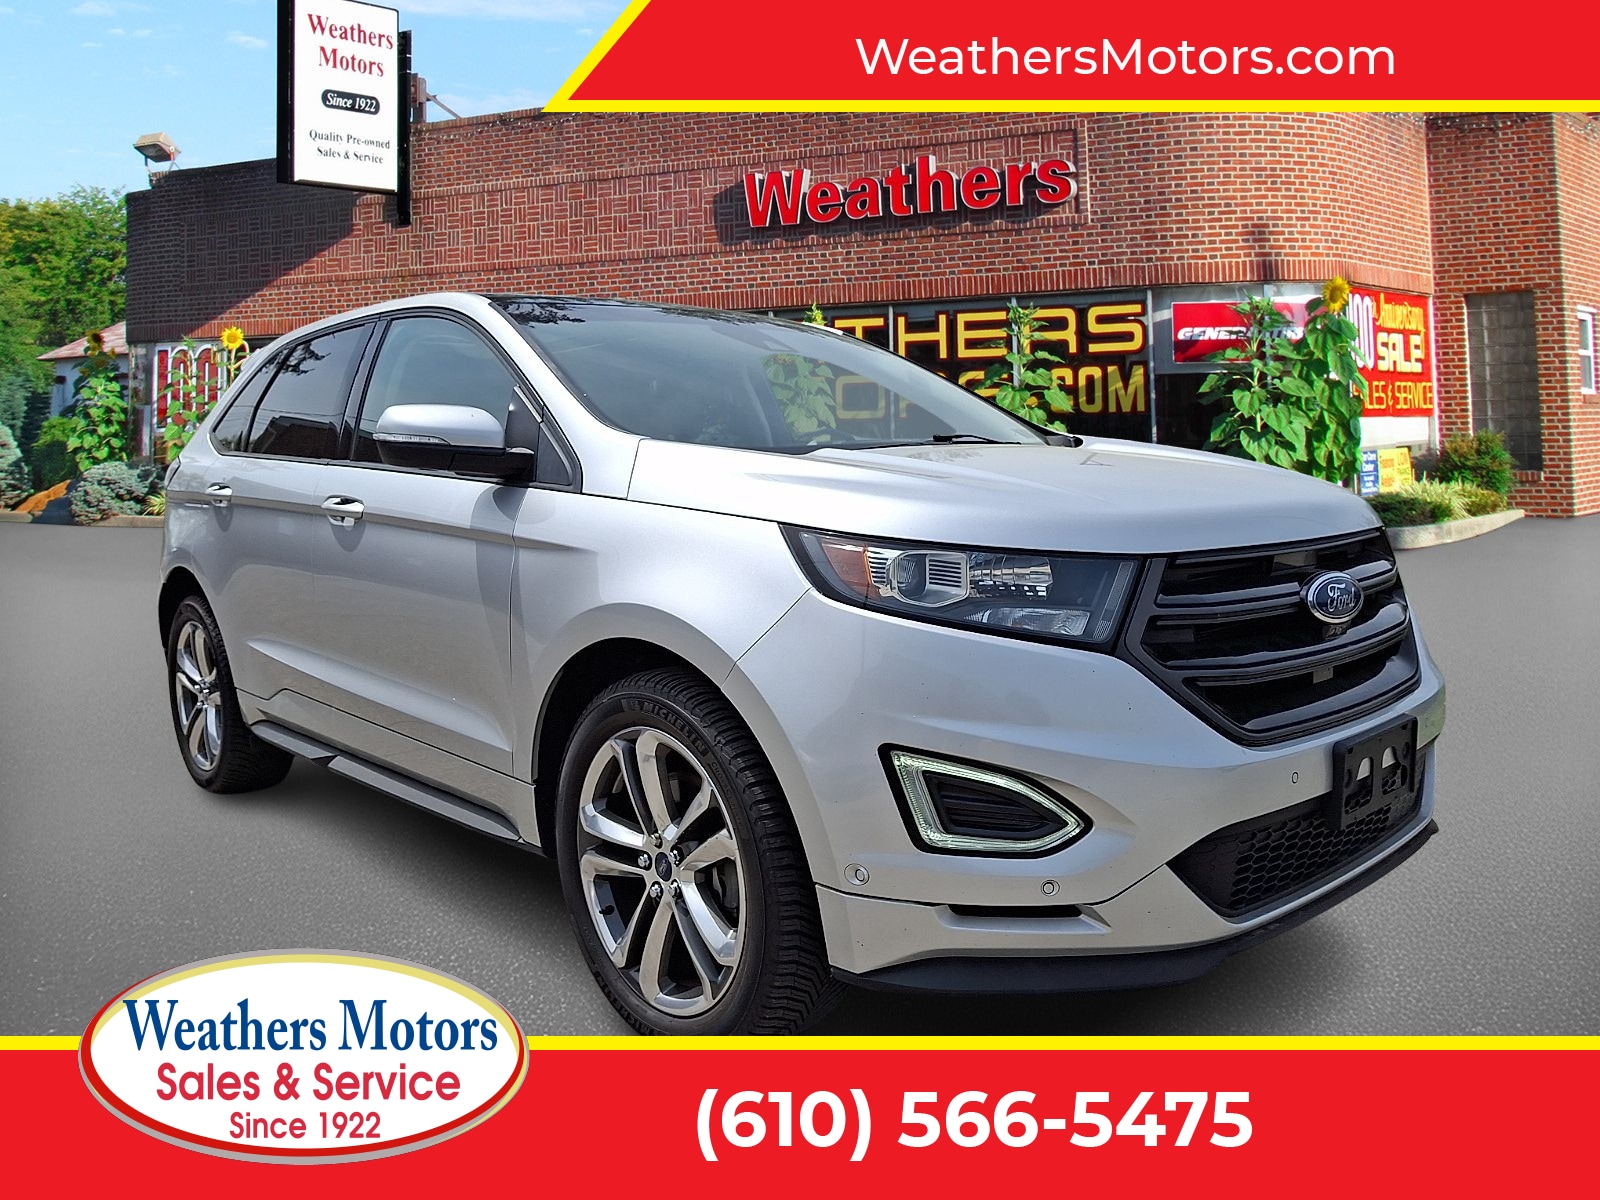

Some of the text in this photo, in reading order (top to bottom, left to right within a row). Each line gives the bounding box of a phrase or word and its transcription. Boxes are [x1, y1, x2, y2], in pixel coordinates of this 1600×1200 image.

[307, 13, 394, 50] Weathers
[319, 46, 384, 77] Motors
[326, 92, 376, 112] Since 1922
[309, 129, 391, 150] Quality Pre-owned
[316, 146, 384, 164] Sales & Service
[743, 155, 1078, 228] Weathers
[1376, 331, 1423, 374] SALE
[1394, 381, 1434, 409] SERVICE
[1327, 583, 1356, 612] Ford
[643, 701, 707, 754] MICHELIN
